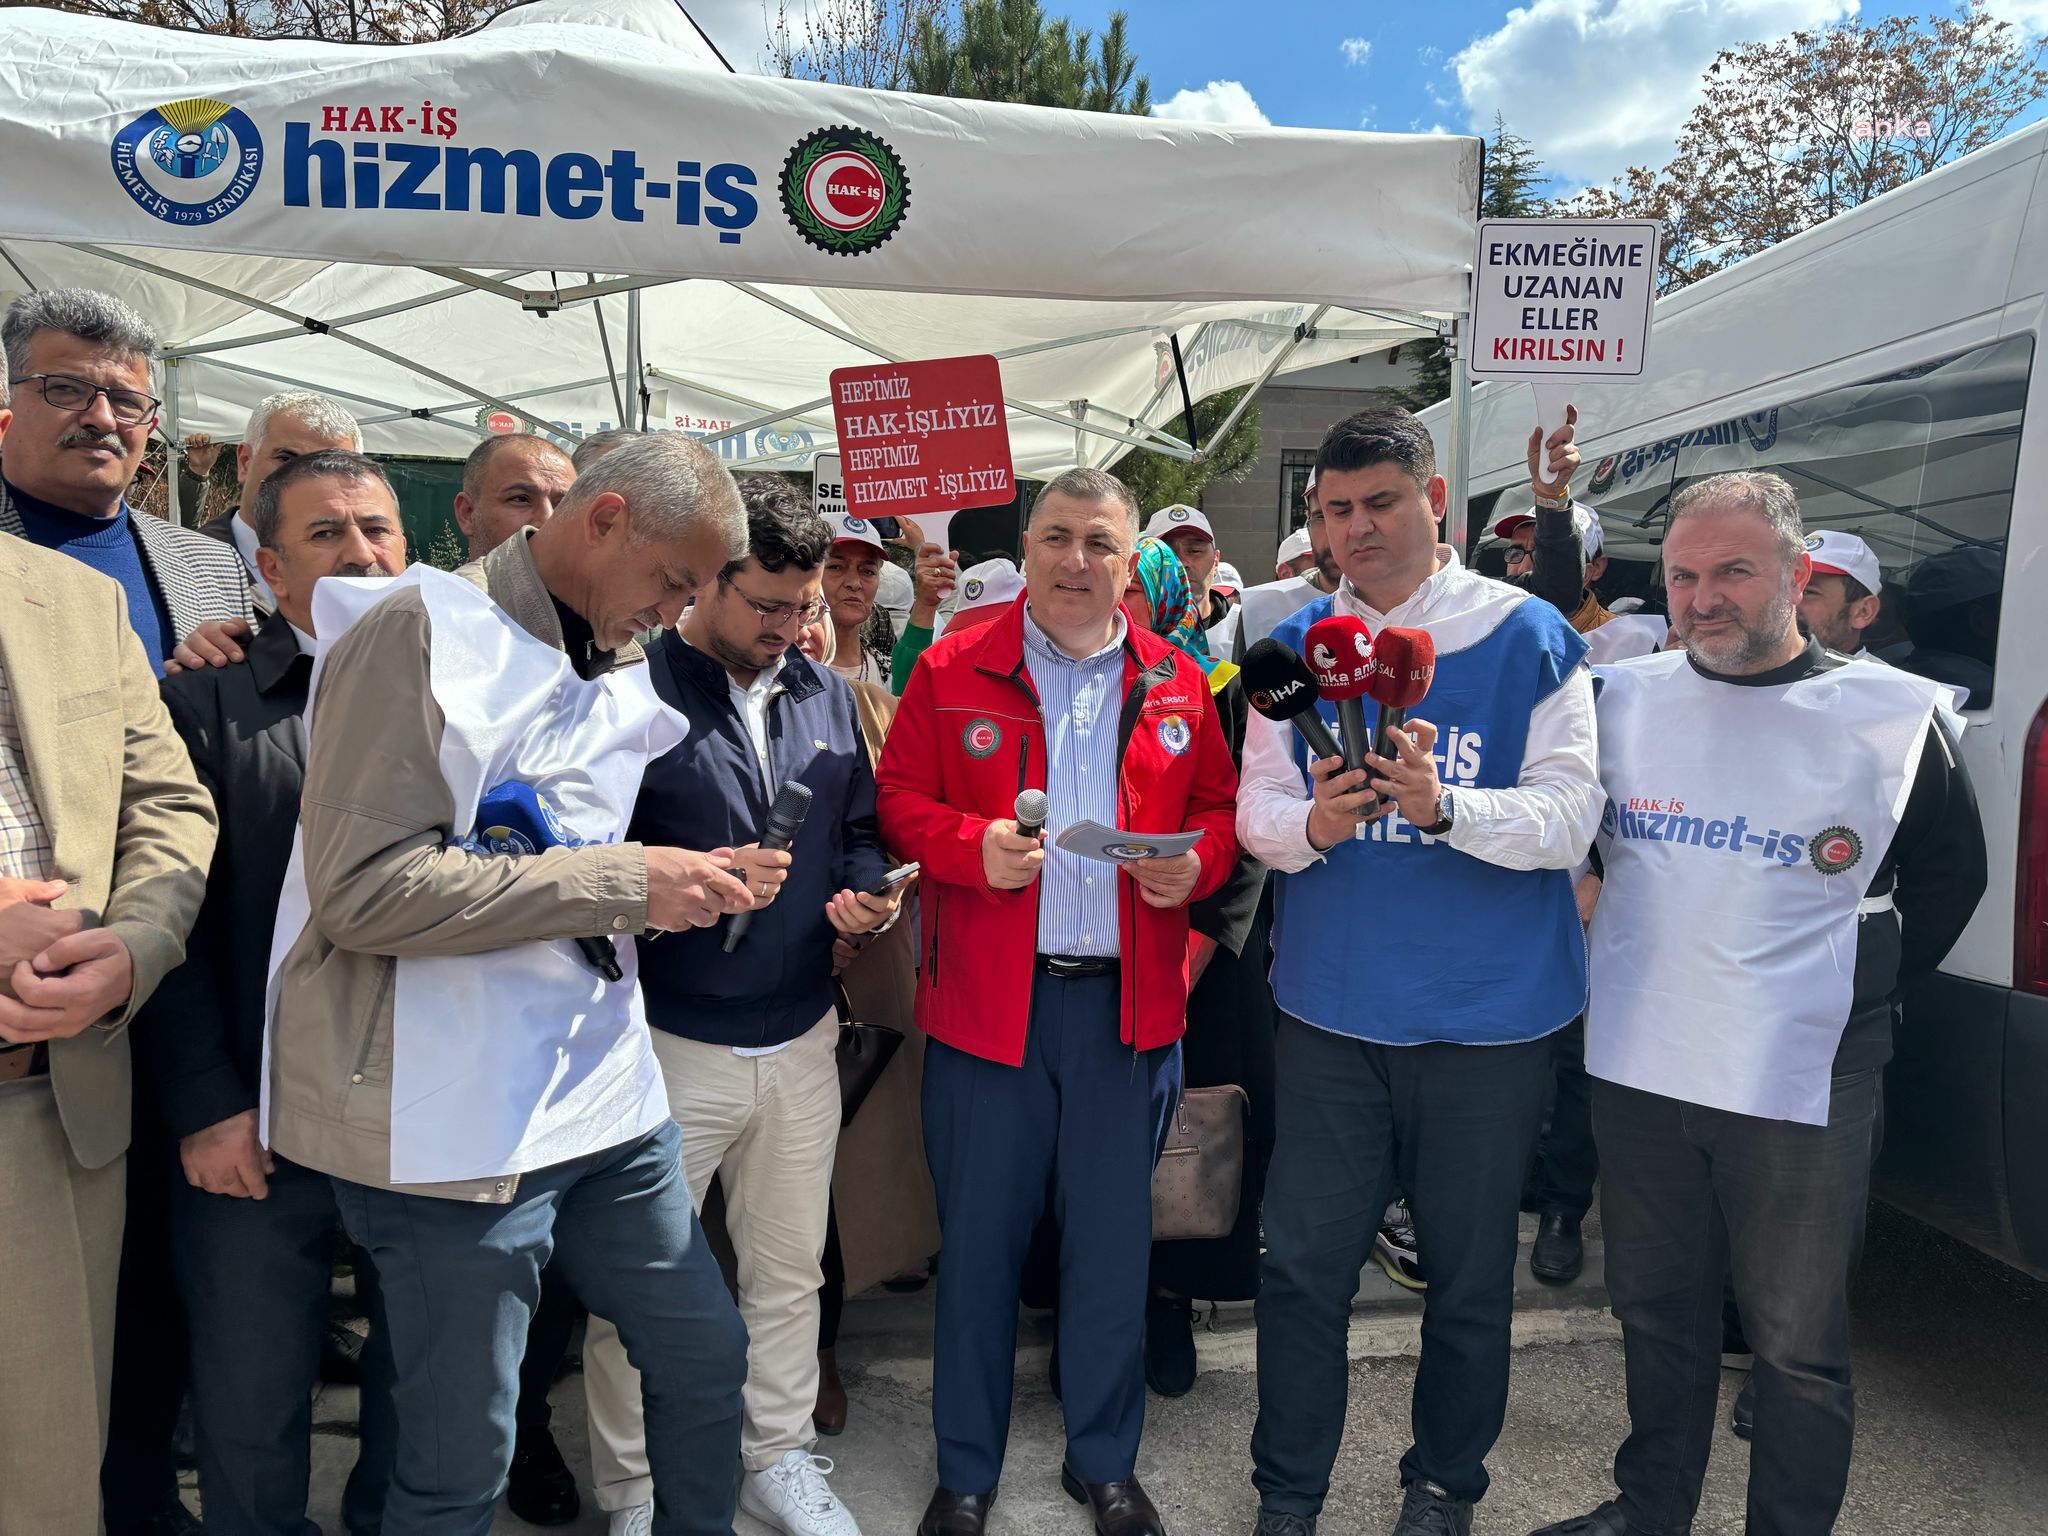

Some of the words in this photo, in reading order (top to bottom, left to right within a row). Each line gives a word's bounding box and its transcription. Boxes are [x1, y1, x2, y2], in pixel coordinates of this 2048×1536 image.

[321, 101, 458, 139] HAK-İŞ
[117, 141, 170, 219] HİZMET-İŞ
[175, 211, 202, 221] 1979
[206, 147, 258, 218] SENDİKASI
[284, 121, 759, 245] hizmet-iş
[827, 183, 881, 201] HAK-İŞ
[1489, 237, 1643, 267] EKMEĞİME
[1504, 276, 1623, 299] UZANAN
[1521, 307, 1598, 331] ELLER
[1493, 337, 1605, 361] KIRILSIN
[838, 371, 911, 404] HEPİMİZ
[844, 398, 998, 439] HAK-İŞLİYİZ
[848, 438, 921, 471] HEPİMİZ
[817, 483, 846, 499] SE
[853, 475, 928, 504] HİZMET
[1316, 669, 1349, 683] nka
[1354, 657, 1378, 677] ank
[1161, 695, 1189, 704] ERSOY
[1270, 678, 1306, 703] İHA
[1619, 803, 1805, 868] hizmet-iş
